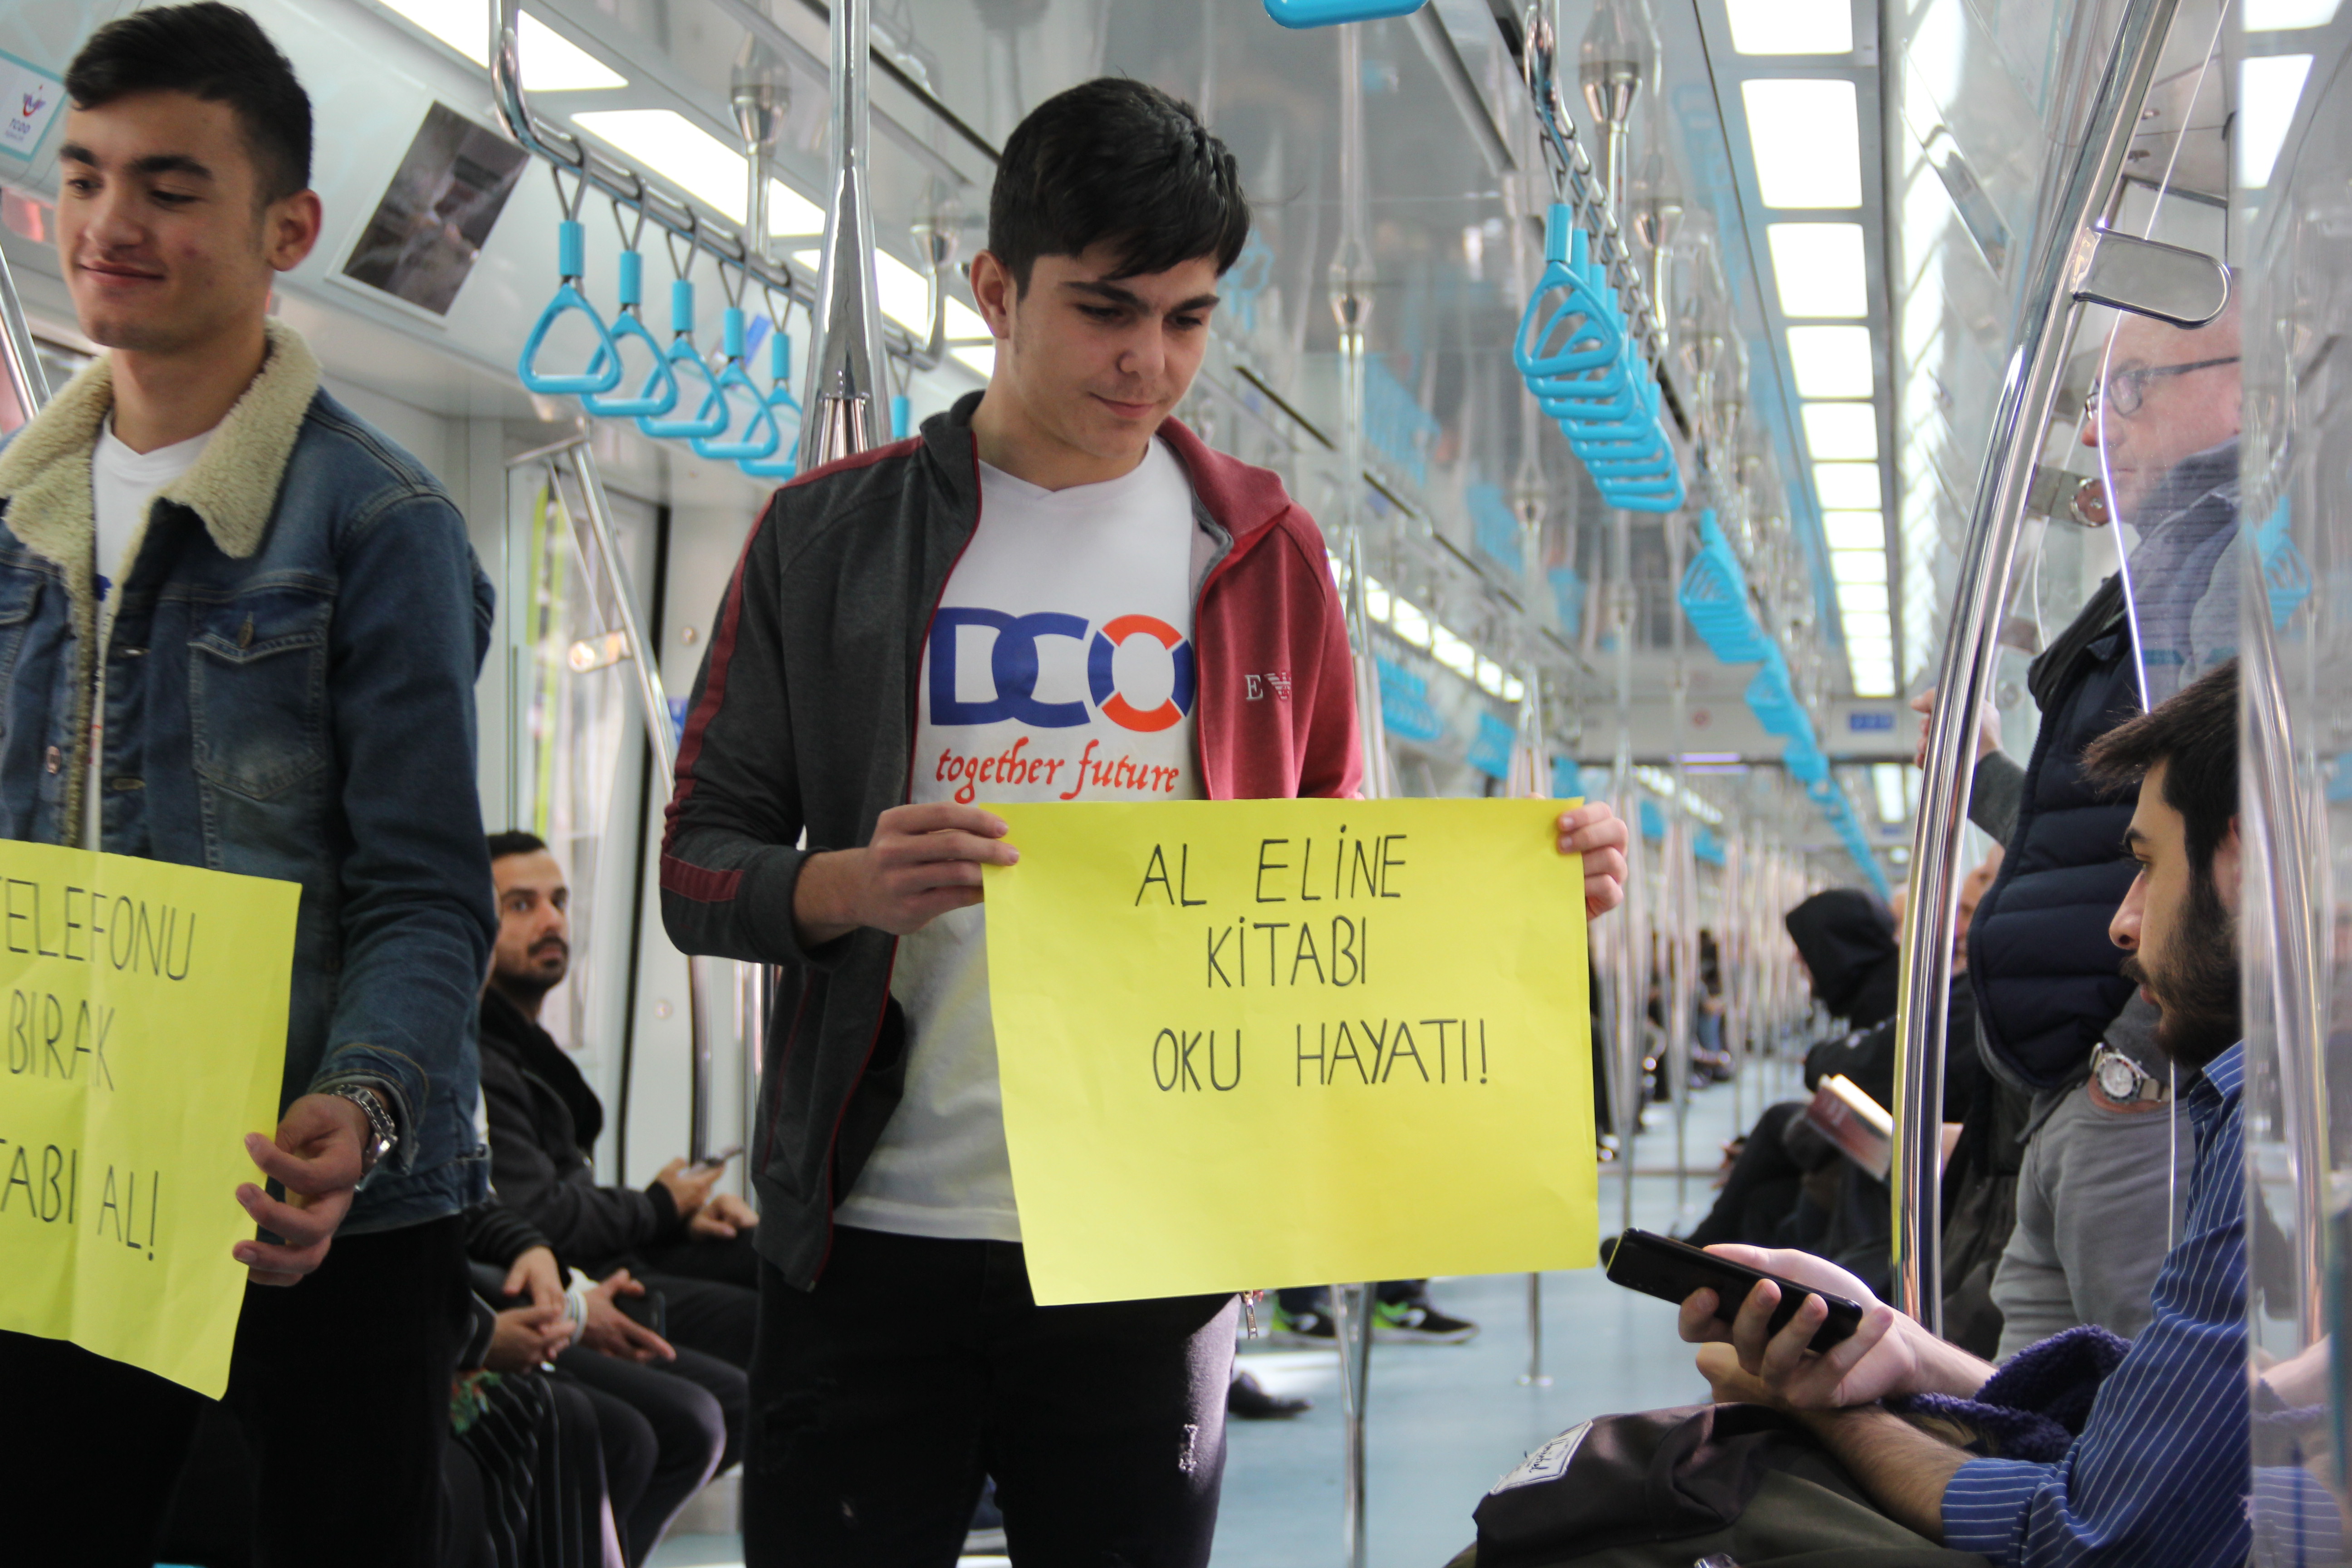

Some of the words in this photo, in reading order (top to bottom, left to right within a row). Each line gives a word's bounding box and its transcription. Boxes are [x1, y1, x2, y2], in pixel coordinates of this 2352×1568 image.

[929, 606, 1196, 732] DCO
[936, 736, 1065, 804] together
[1059, 739, 1180, 800] future
[1134, 843, 1208, 908] AL
[1255, 823, 1407, 903] ELİNE
[0, 876, 196, 981] ELEFONU
[1207, 915, 1366, 989] KİTABI
[8, 989, 115, 1091] BIRAK
[1152, 1027, 1242, 1093] OKU
[1296, 1017, 1488, 1087] HAYATI!
[0, 1138, 77, 1225] ABI
[97, 1164, 159, 1262] AL!
